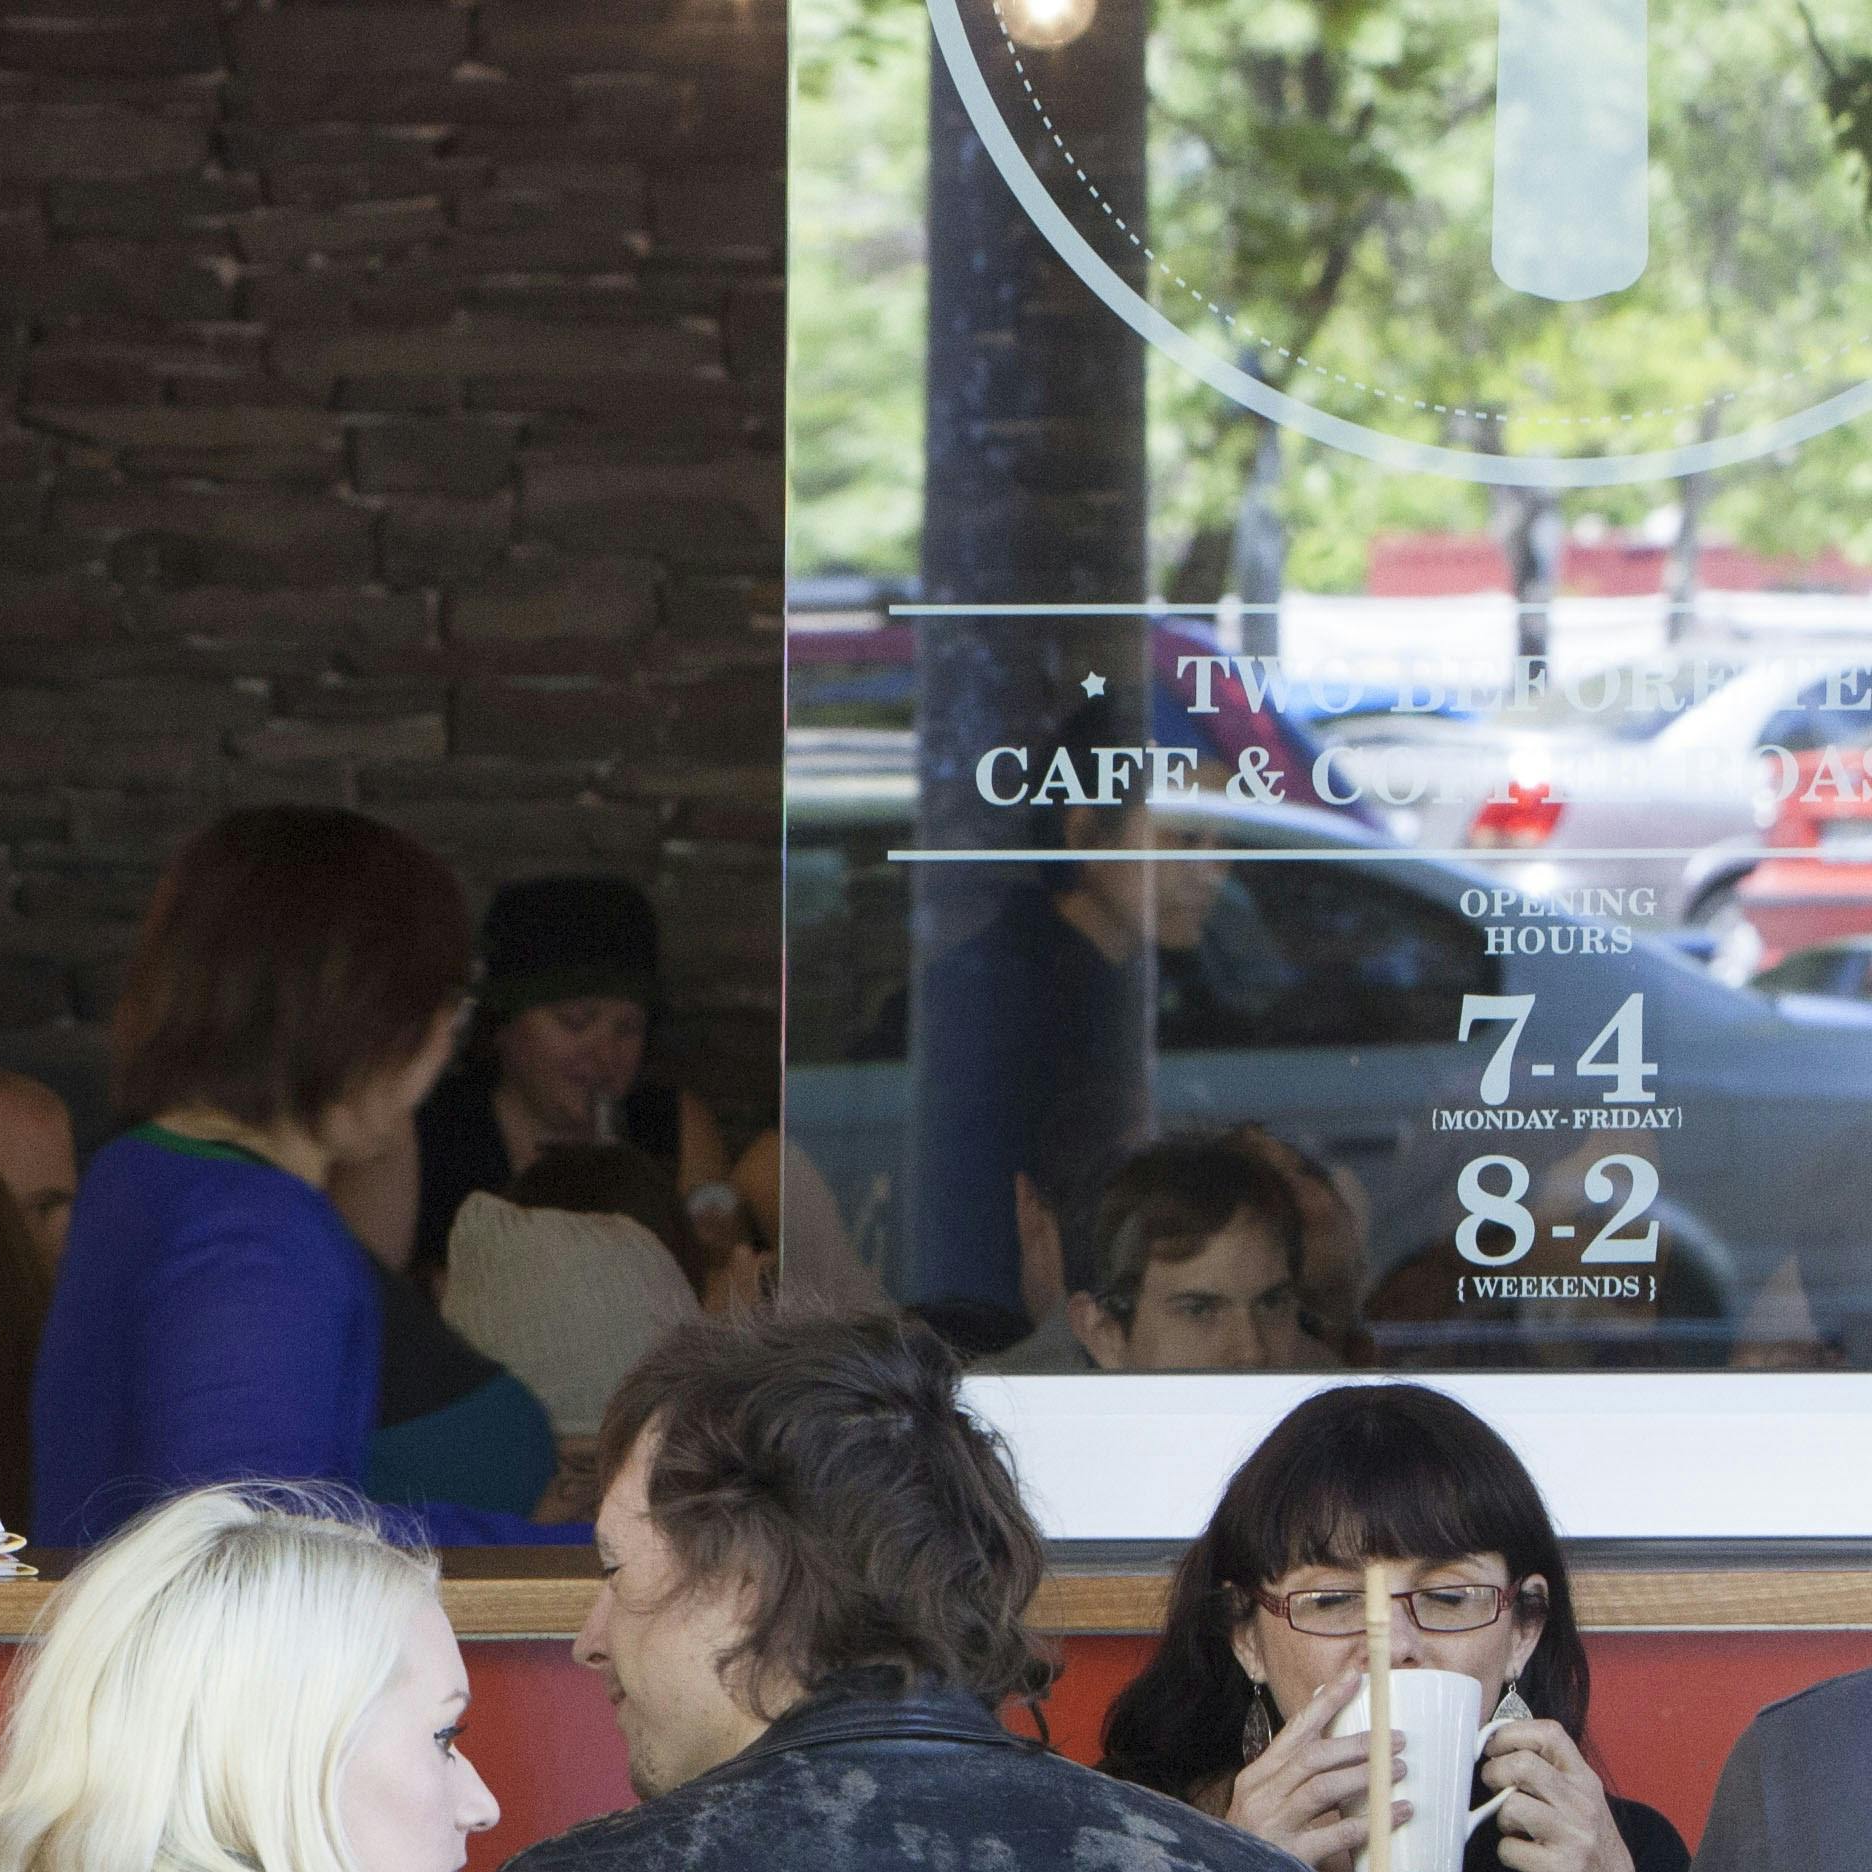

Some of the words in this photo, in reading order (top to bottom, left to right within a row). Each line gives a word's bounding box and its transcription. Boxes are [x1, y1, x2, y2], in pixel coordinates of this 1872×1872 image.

[1177, 656, 1364, 713] TWO
[1390, 655, 1740, 712] BEFORE
[975, 745, 1199, 806] CAFE
[1225, 745, 1285, 805] &
[1459, 887, 1657, 918] OPENING
[1484, 926, 1633, 956] HOURS
